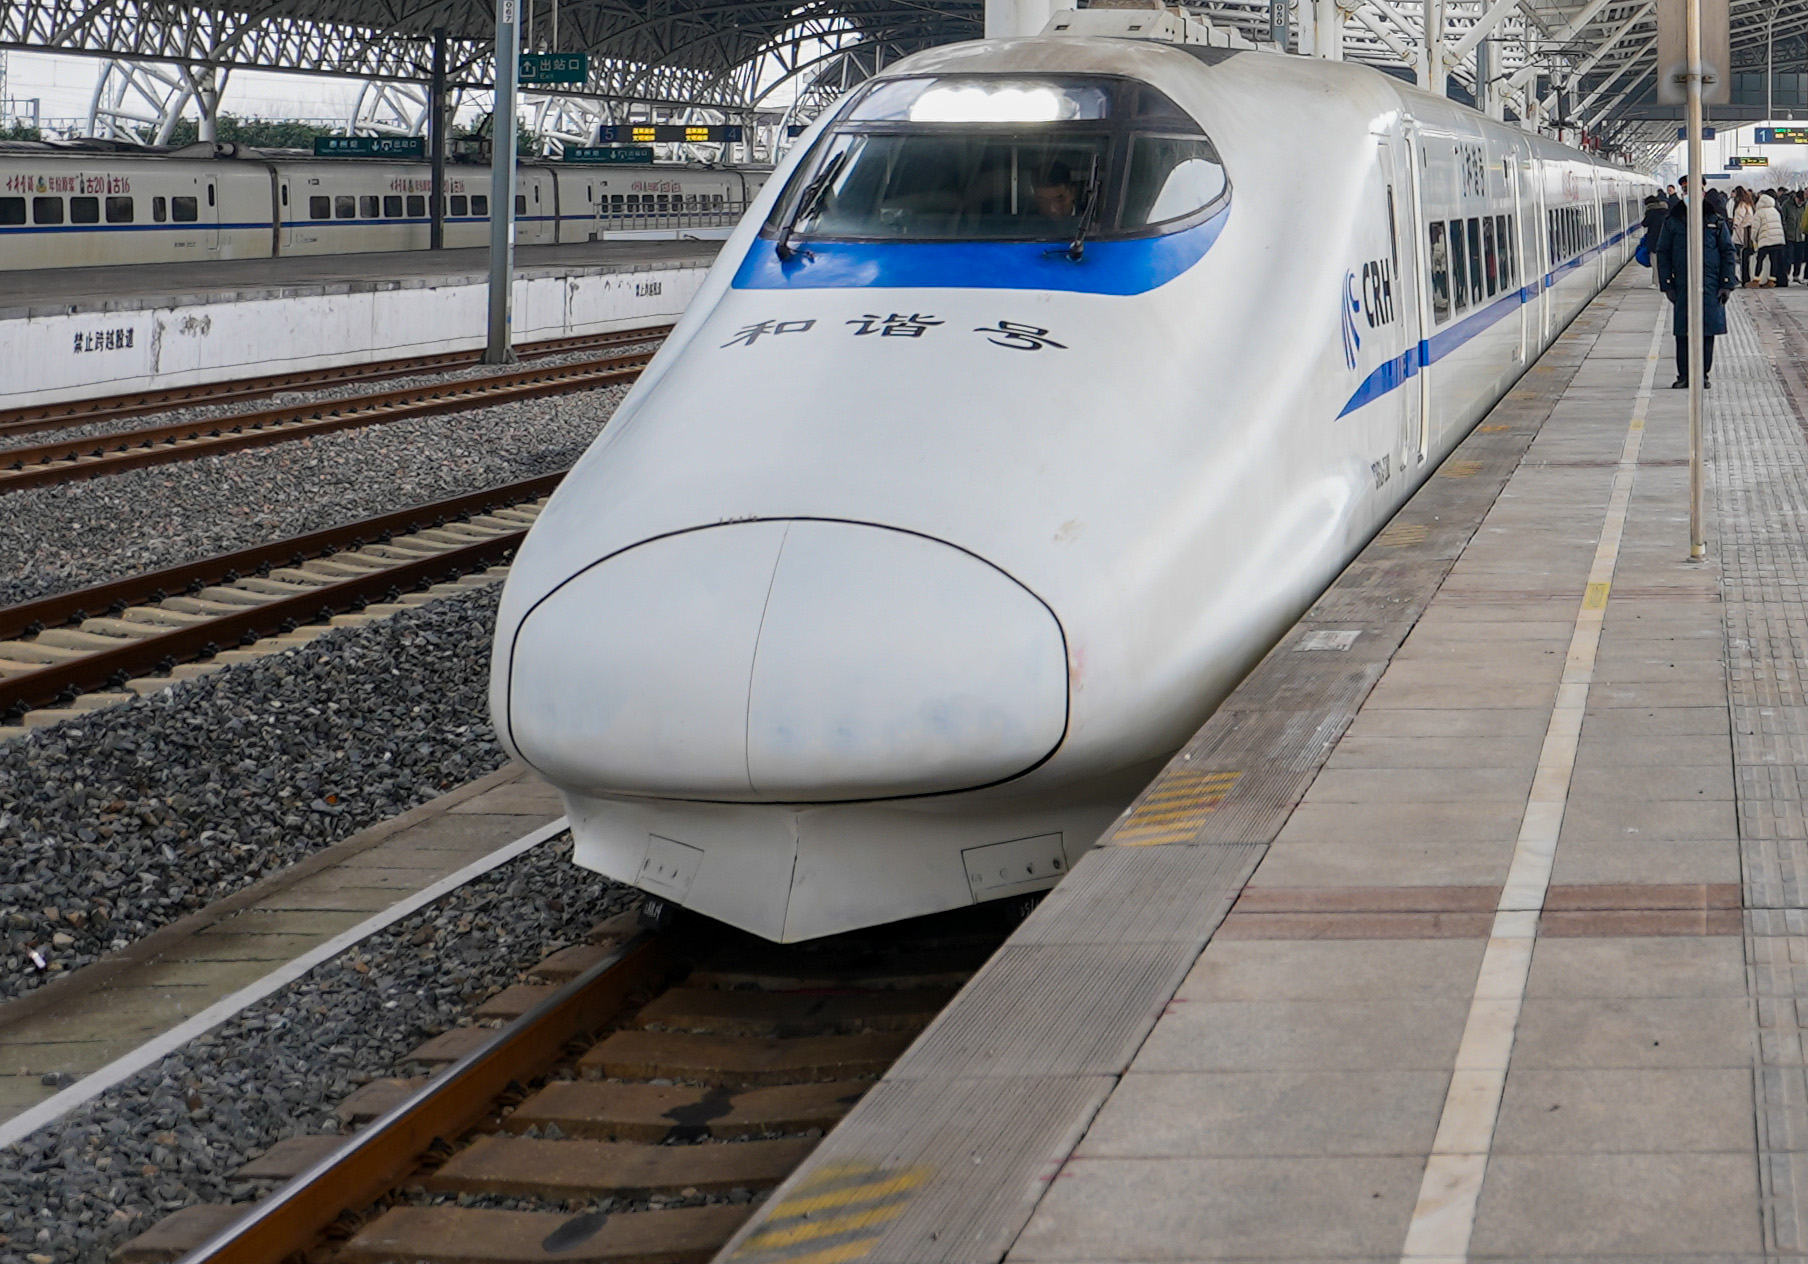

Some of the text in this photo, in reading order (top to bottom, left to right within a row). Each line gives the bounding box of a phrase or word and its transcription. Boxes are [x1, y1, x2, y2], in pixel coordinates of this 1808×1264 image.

[540, 58, 580, 71] 出站口
[605, 127, 614, 140] 5
[728, 127, 737, 140] 4
[1759, 129, 1766, 142] 1
[1362, 257, 1395, 329] CRH
[719, 312, 1069, 352] 和谐号
[73, 327, 134, 354] 禁止跨越股道
